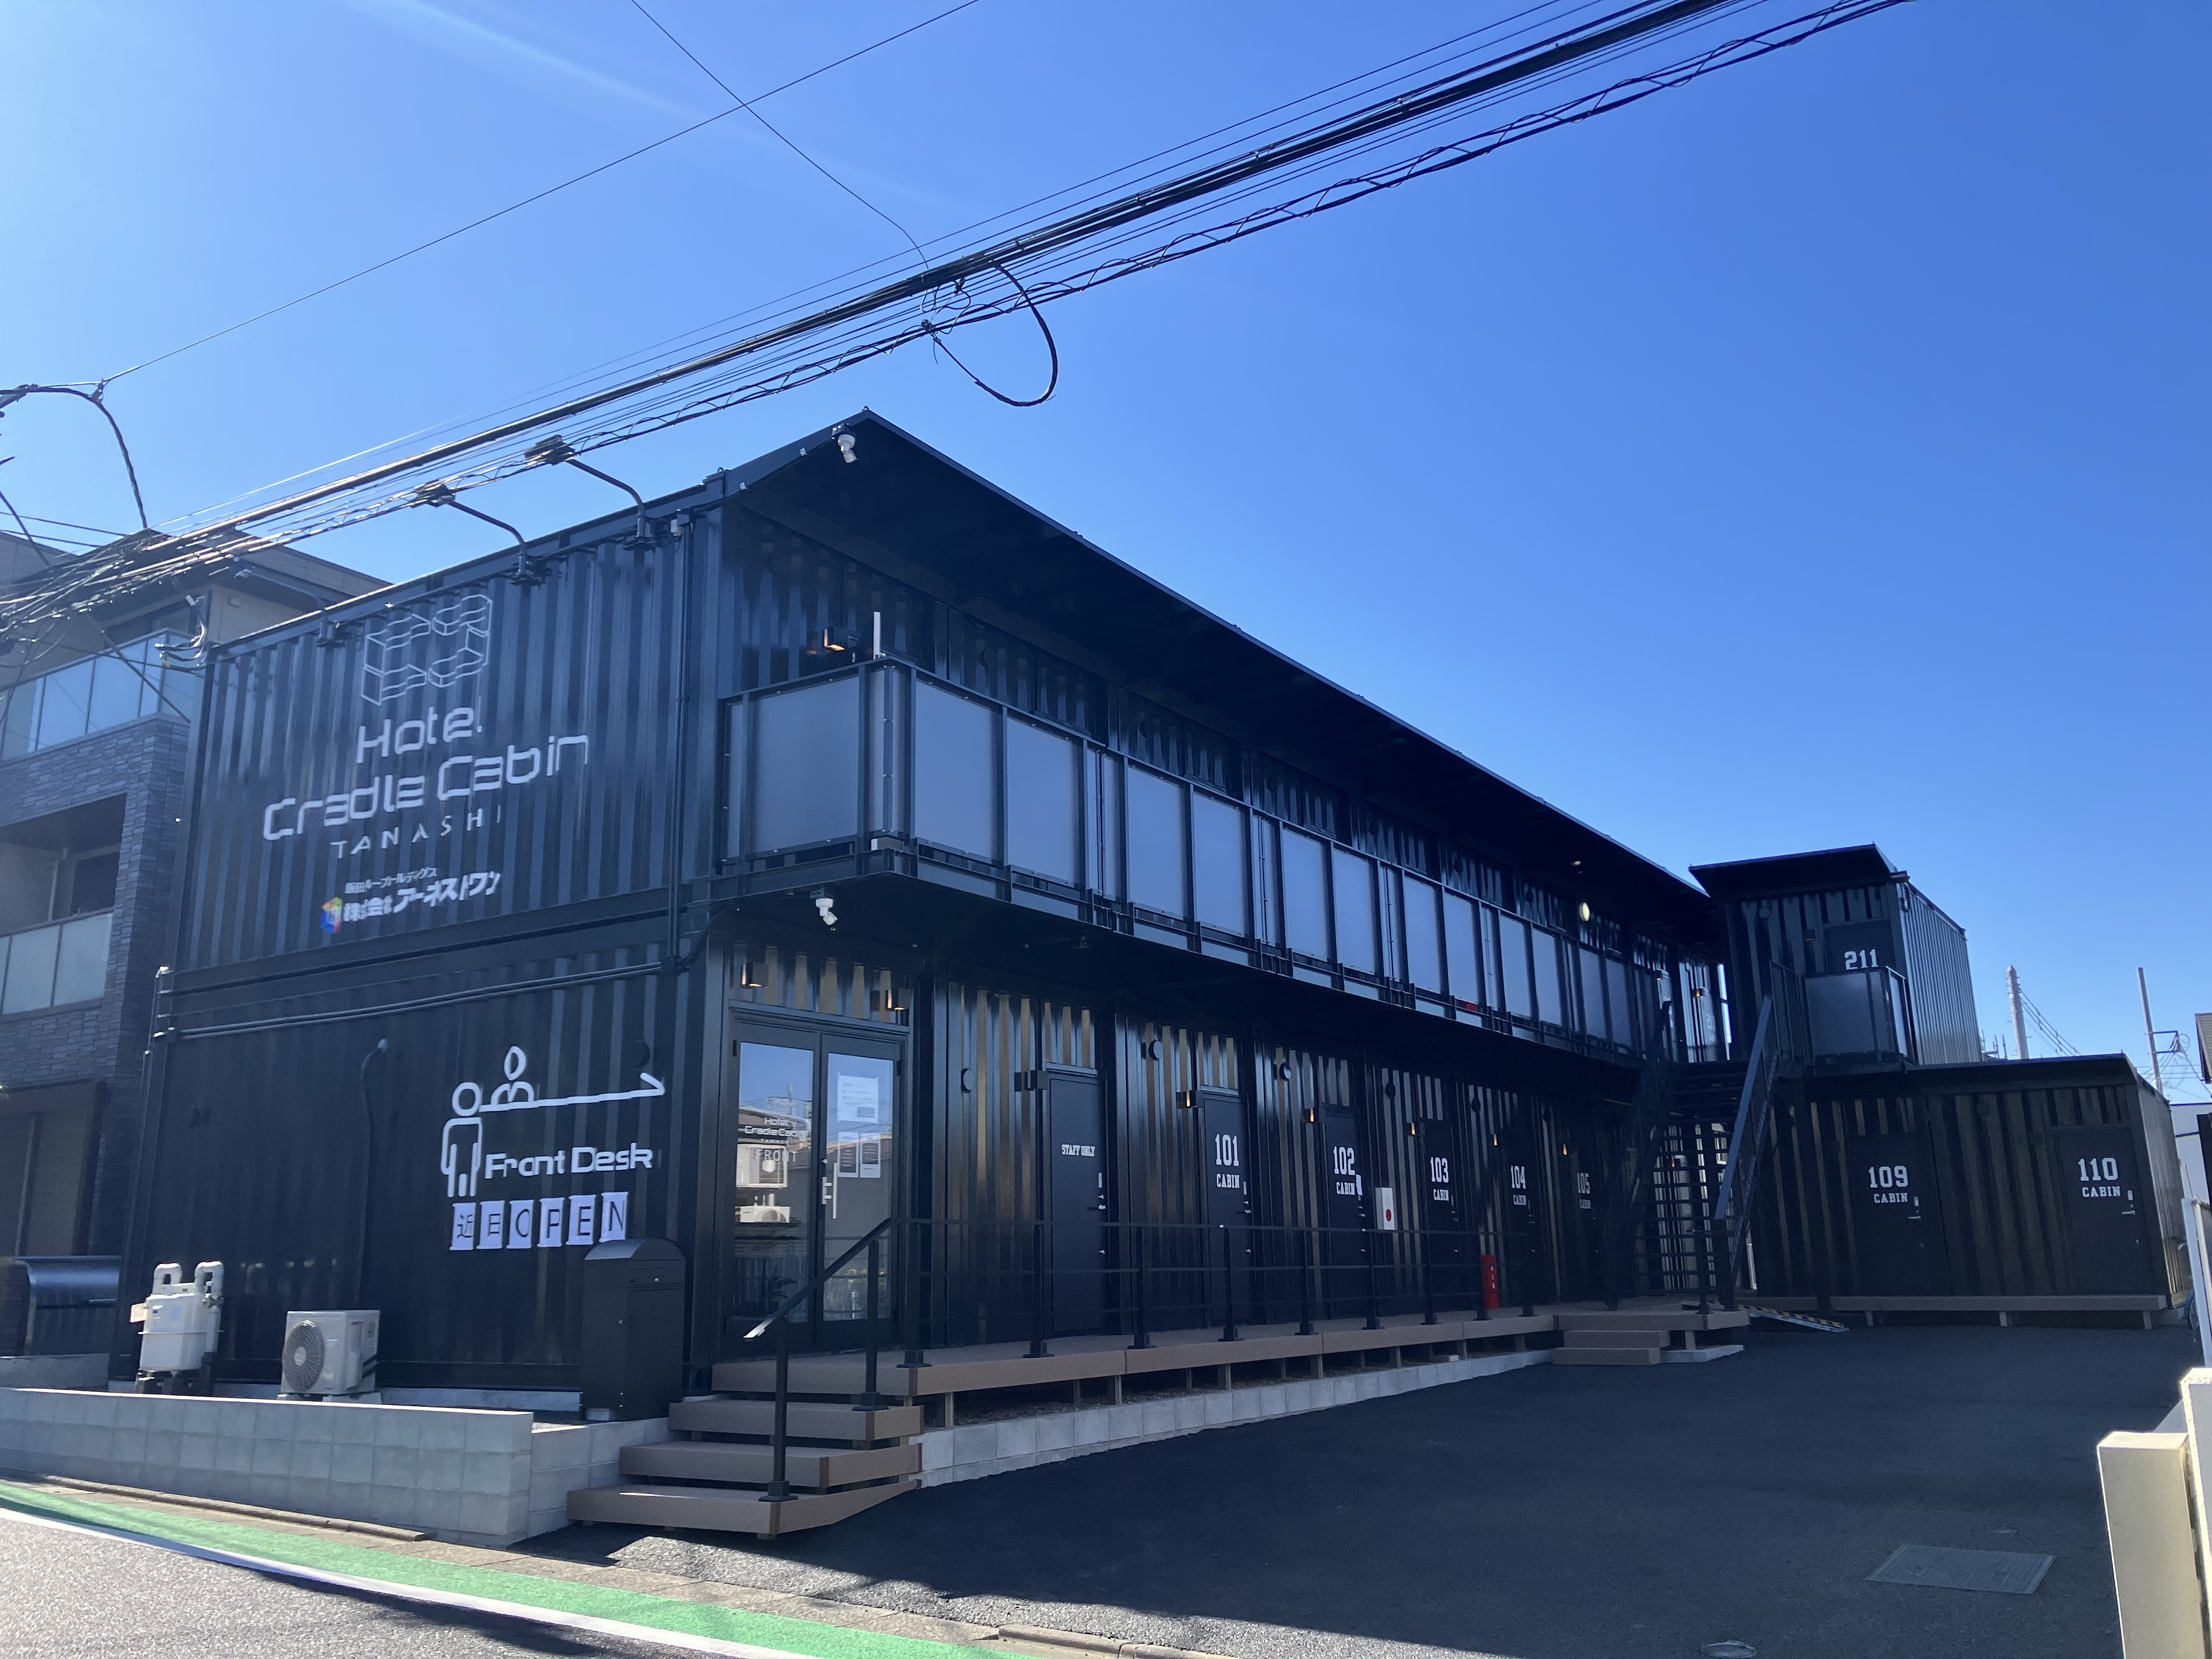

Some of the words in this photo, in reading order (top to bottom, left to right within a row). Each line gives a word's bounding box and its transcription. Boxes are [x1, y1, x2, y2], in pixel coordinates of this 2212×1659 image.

[263, 774, 425, 841] Cradle
[438, 735, 589, 801] Cabin
[330, 804, 500, 859] TANASHI
[1844, 949, 1879, 970] 211
[485, 1150, 565, 1179] Front
[571, 1142, 653, 1173] Desk
[753, 1149, 798, 1162] FRONT
[1061, 1144, 1080, 1156] STAFF
[1081, 1146, 1096, 1157] ONLY
[1215, 1133, 1239, 1167] 101
[1333, 1146, 1356, 1176] 102
[1216, 1173, 1240, 1189] CABIN
[1430, 1156, 1449, 1183] 103
[1510, 1165, 1526, 1189] 104
[1868, 1165, 1909, 1188] 109
[2078, 1158, 2118, 1181] 110
[1336, 1181, 1355, 1195] CABIN
[1577, 1172, 1590, 1194] 105
[2082, 1186, 2121, 1198] CABIN
[1874, 1192, 1908, 1204] CABIN
